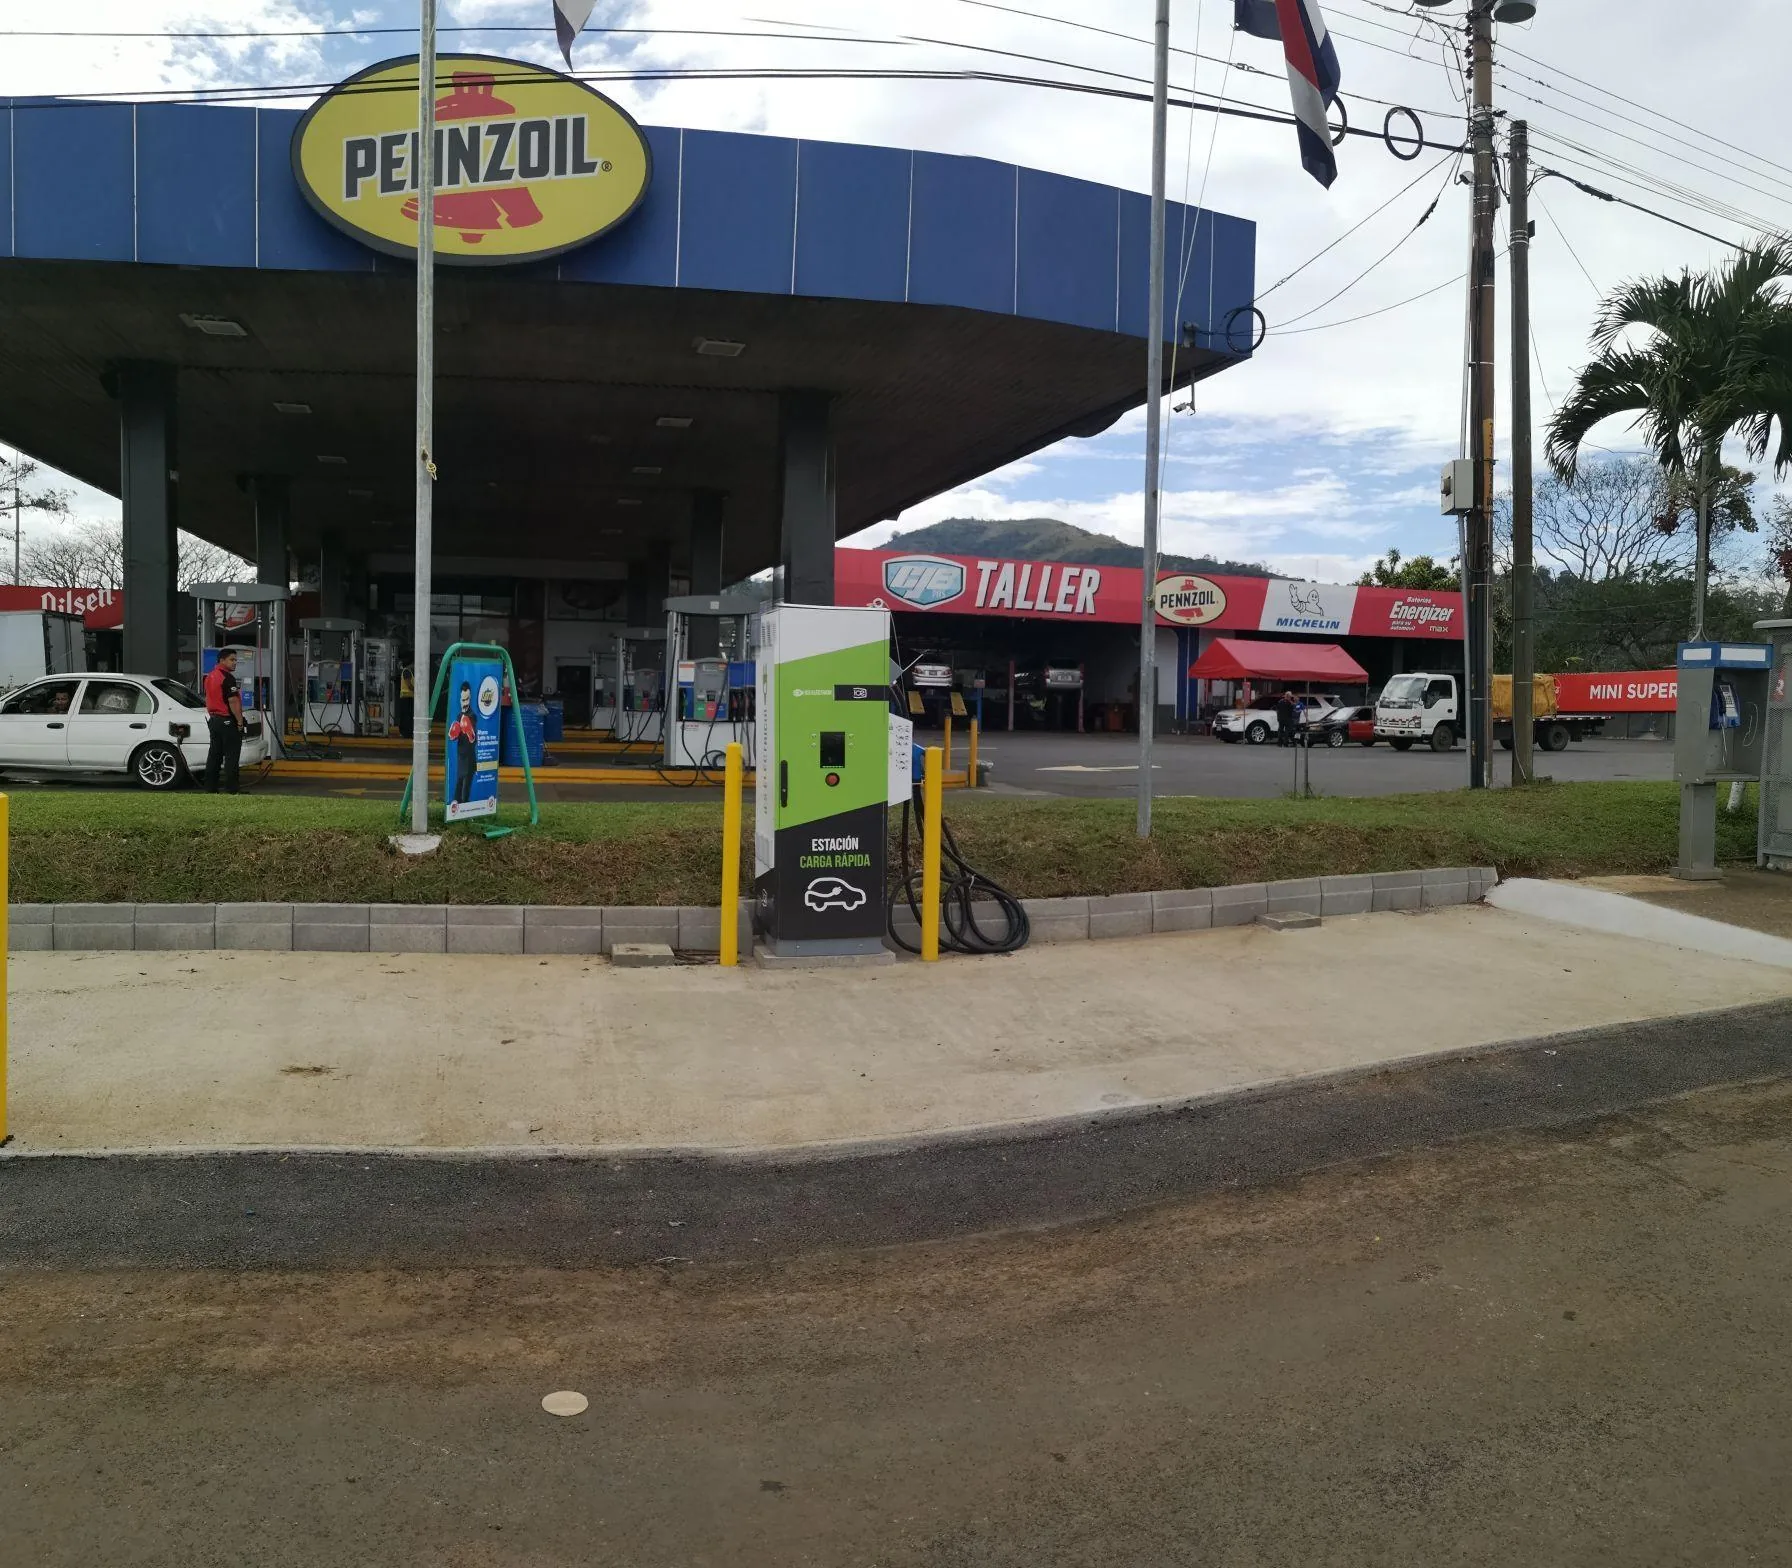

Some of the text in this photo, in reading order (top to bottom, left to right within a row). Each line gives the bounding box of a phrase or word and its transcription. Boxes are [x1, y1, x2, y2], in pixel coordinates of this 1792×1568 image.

[975, 561, 1101, 615] TALLER
[1160, 590, 1215, 608] PENNZOIL
[1389, 600, 1455, 625] Energizer
[1276, 617, 1340, 629] MICHELIN
[1429, 625, 1449, 633] max
[1589, 682, 1678, 700] MINI SUPER
[811, 835, 859, 852] ESTACIÓN
[800, 852, 871, 868] CARGA RÁPIDA
